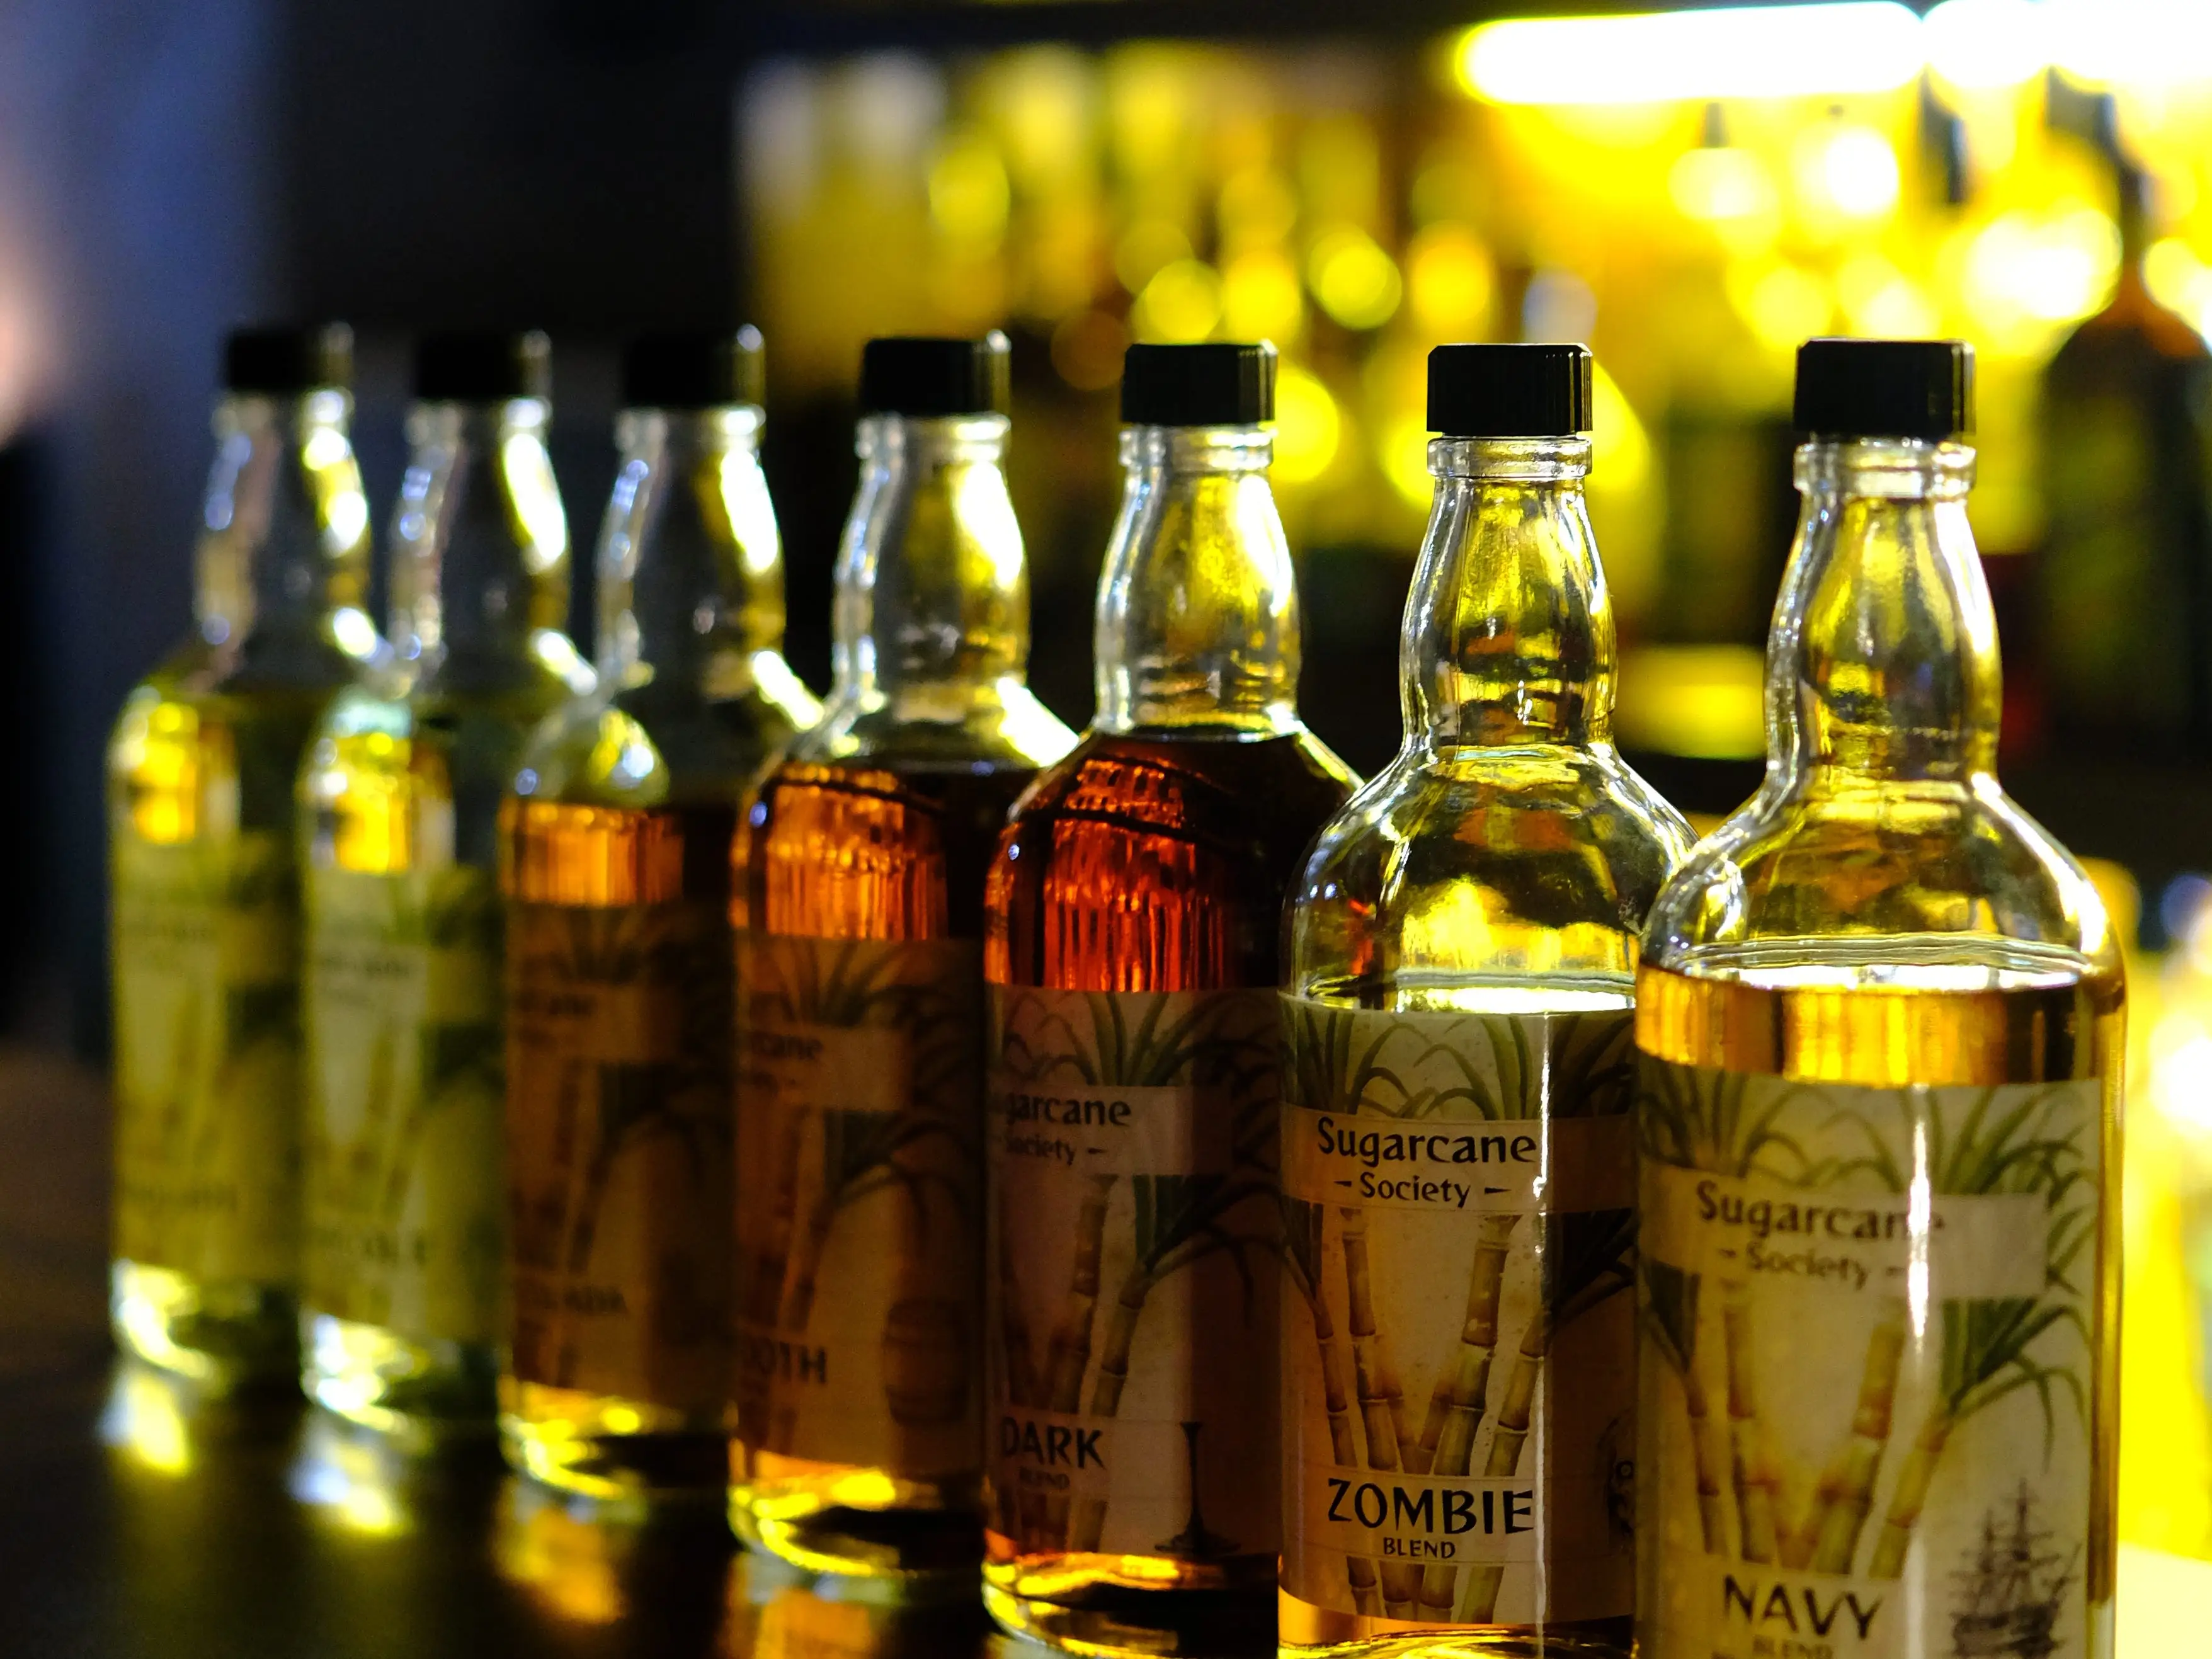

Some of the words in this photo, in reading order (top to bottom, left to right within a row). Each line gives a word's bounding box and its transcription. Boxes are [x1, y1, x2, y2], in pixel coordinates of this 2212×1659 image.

[1318, 1117, 1537, 1168] Sugarcane
[1359, 1171, 1472, 1209] Society
[1696, 1179, 1946, 1239] Sugarcan
[1745, 1241, 1869, 1291] Society
[1001, 1416, 1107, 1471] DARK
[1327, 1477, 1534, 1535] ZOMBIE
[1382, 1537, 1456, 1559] BLEND
[1723, 1573, 1882, 1640] NAVY
